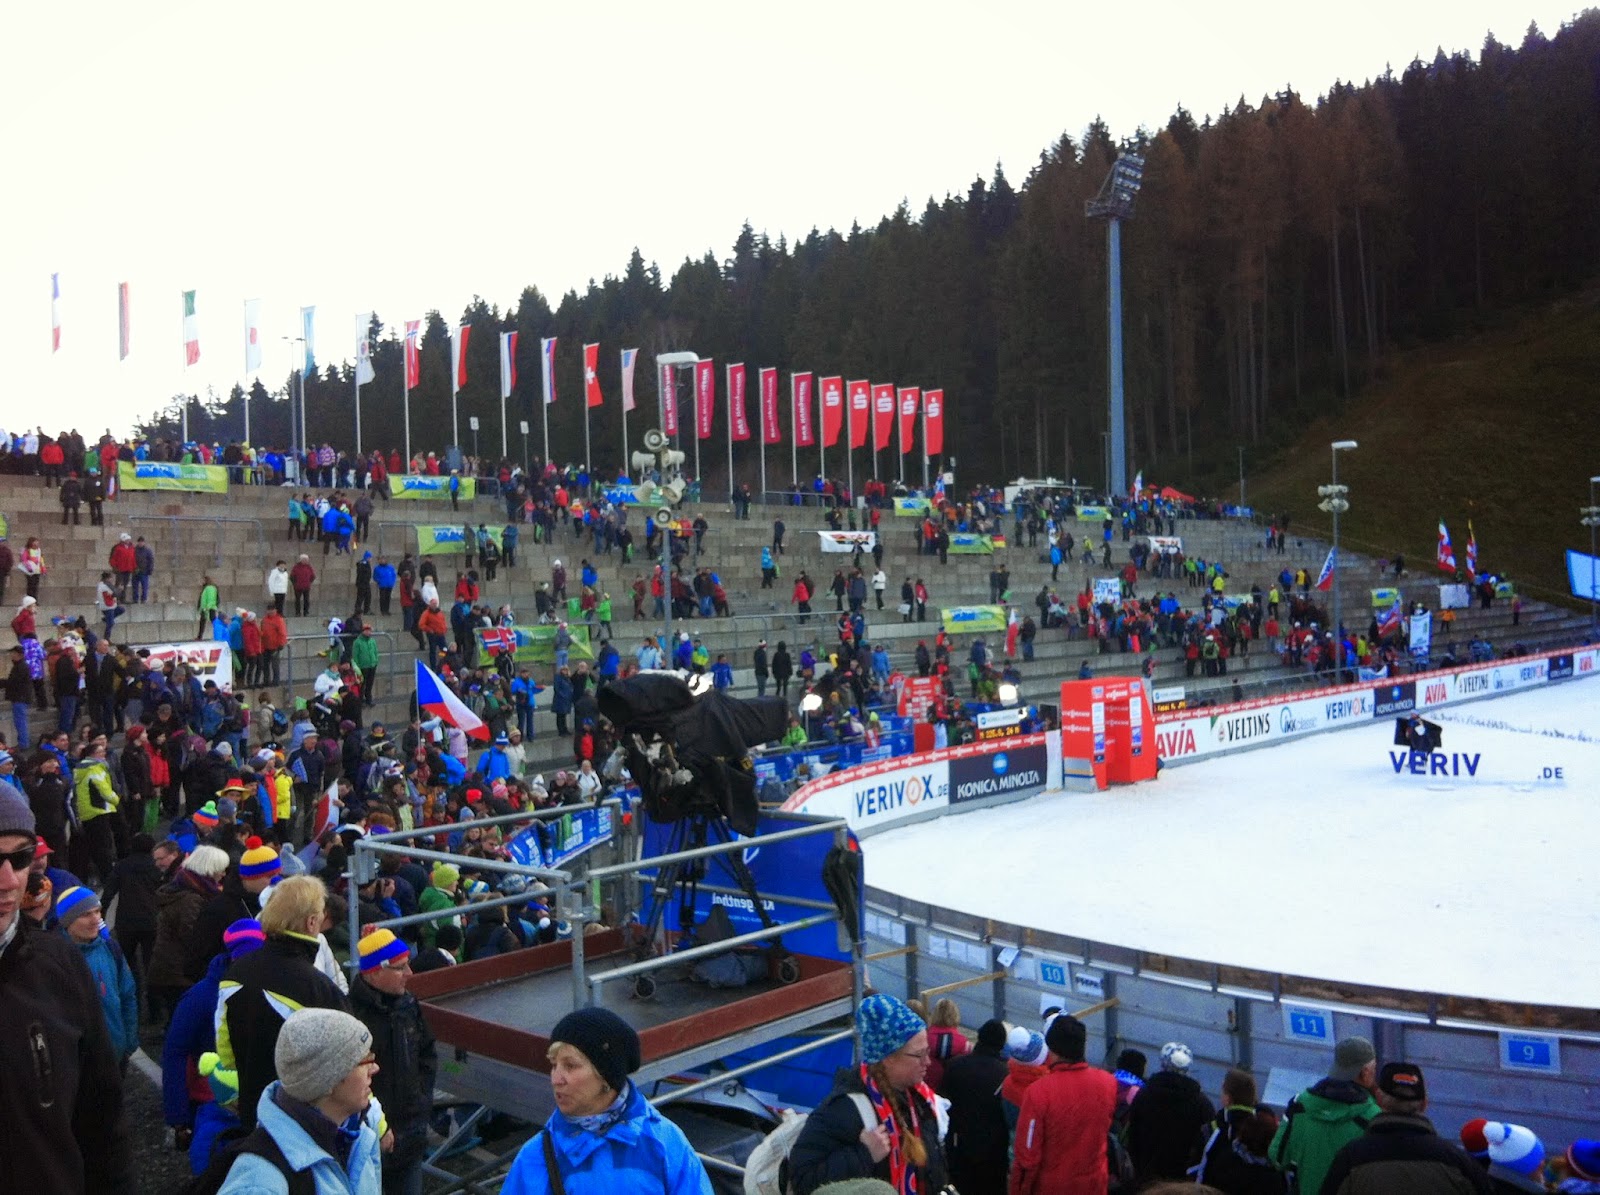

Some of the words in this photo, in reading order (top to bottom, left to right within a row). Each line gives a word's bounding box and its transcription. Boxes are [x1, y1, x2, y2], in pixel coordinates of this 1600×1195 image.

[1424, 678, 1448, 704] AVIA
[1227, 713, 1270, 742] VELTINS
[957, 779, 997, 799] KONICA
[1000, 770, 1039, 790] MINOLTA
[1046, 966, 1062, 982] 10
[1298, 1017, 1319, 1034] 11
[1523, 1045, 1534, 1060] 9
